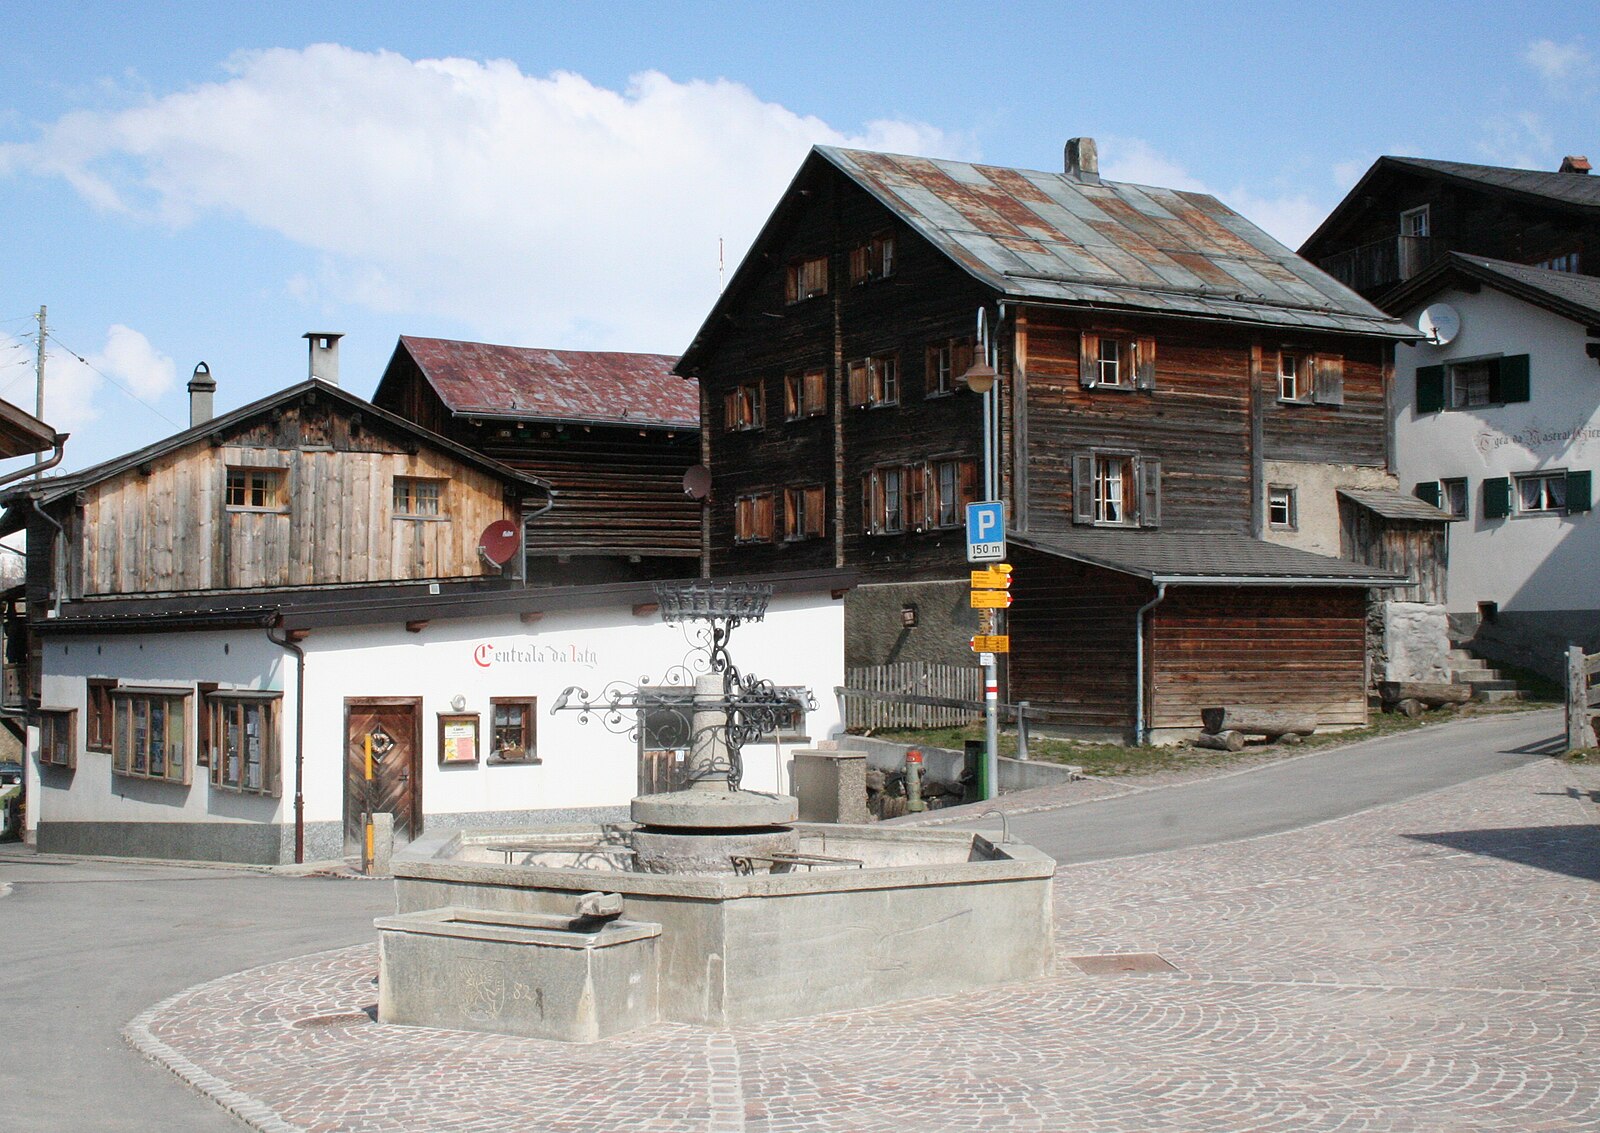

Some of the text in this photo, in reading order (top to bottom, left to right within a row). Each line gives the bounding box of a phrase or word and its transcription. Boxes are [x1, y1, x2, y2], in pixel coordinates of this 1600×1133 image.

[978, 510, 995, 540] P
[972, 544, 1000, 554] 150 m
[474, 643, 544, 667] Centrala
[545, 645, 566, 662] da
